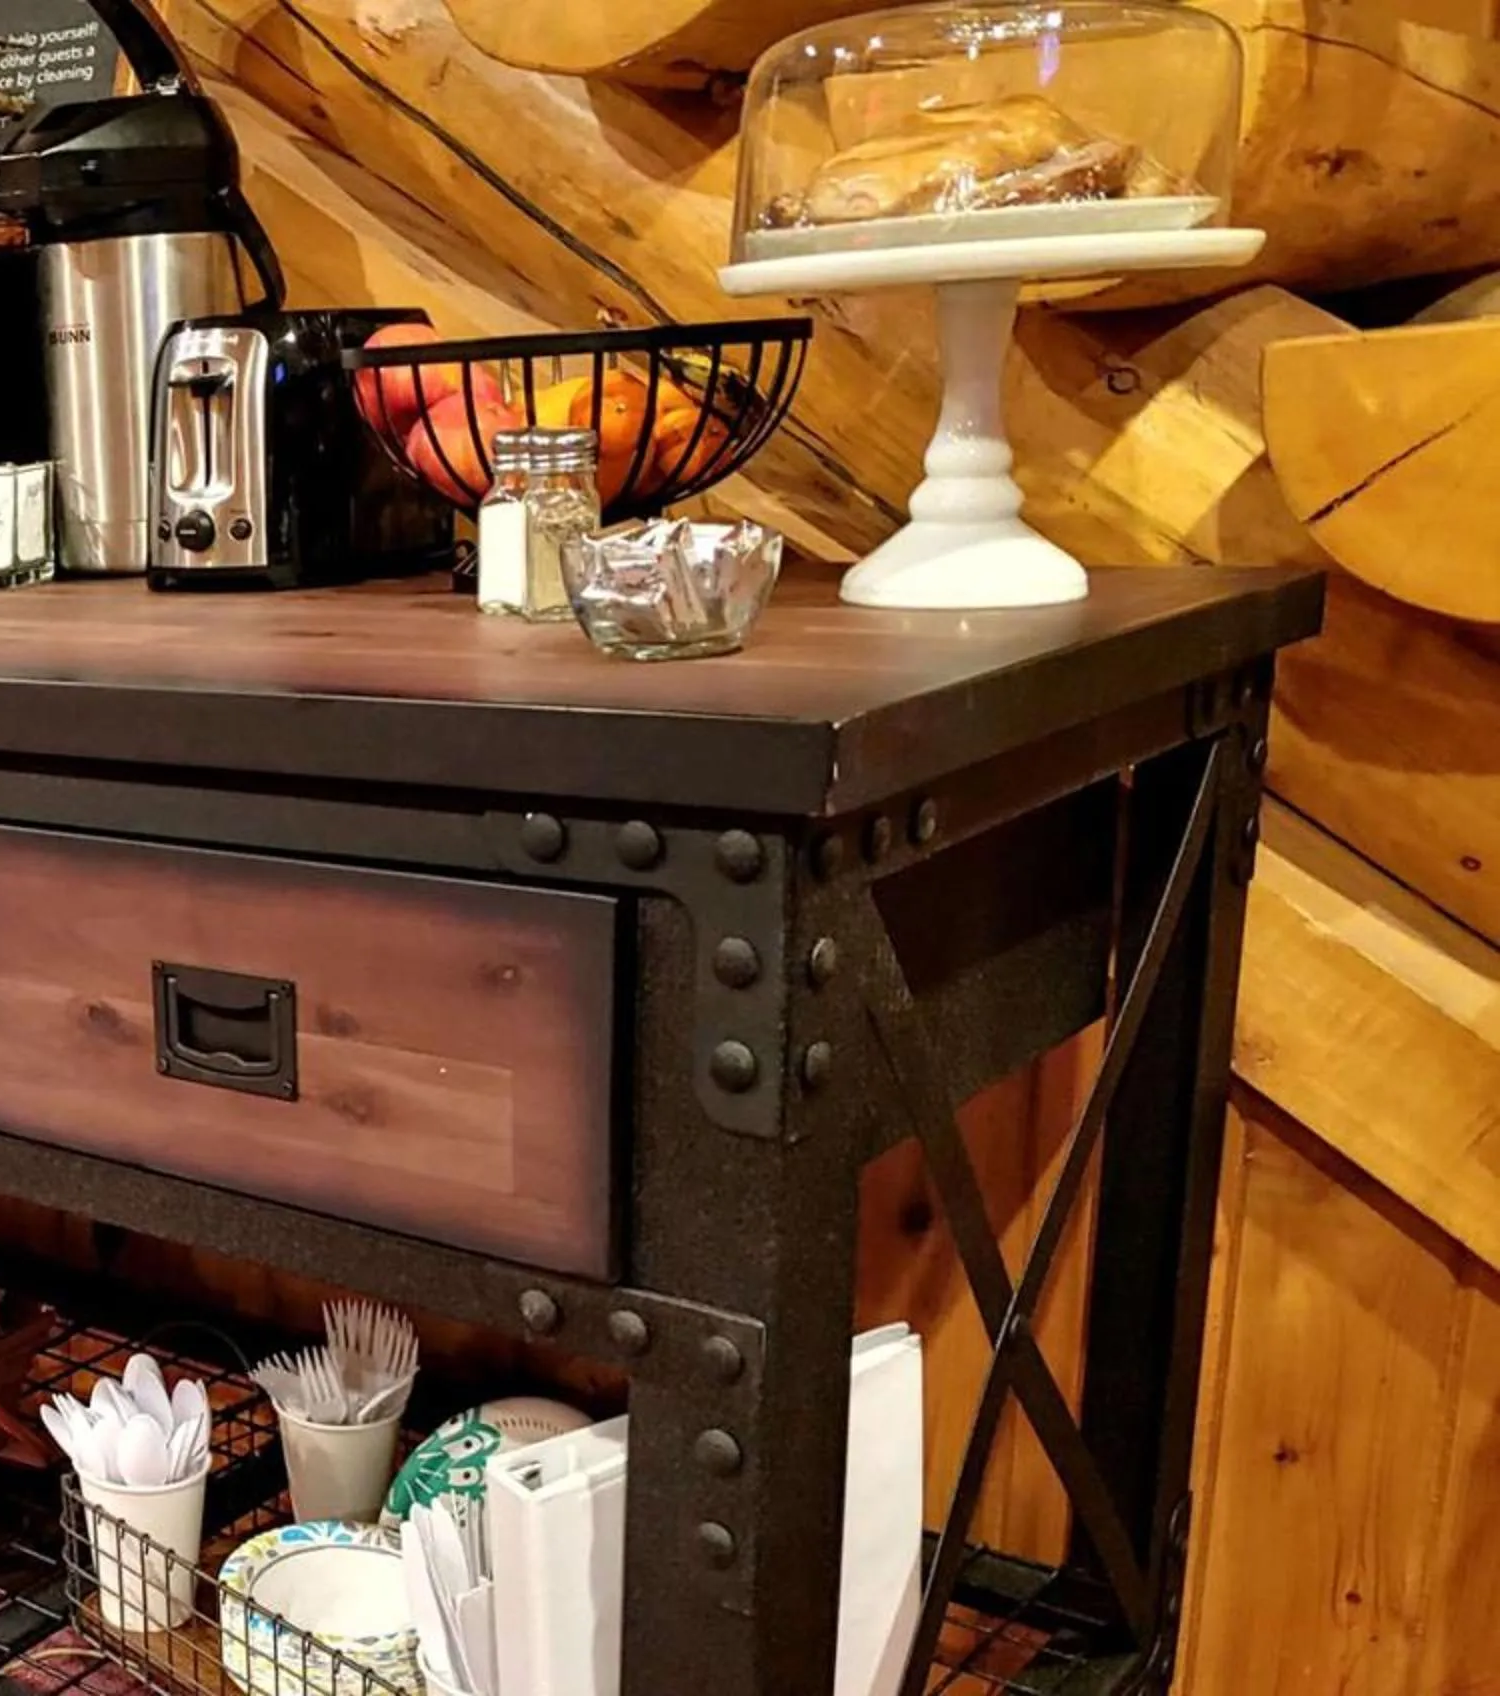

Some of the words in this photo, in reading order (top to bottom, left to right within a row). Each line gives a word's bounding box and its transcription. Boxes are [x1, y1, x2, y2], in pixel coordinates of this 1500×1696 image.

[0, 53, 37, 69] other
[38, 47, 83, 68] guests
[85, 45, 95, 58] a
[16, 71, 35, 89] by
[36, 65, 94, 84] cleaning
[48, 329, 91, 345] BUNN
